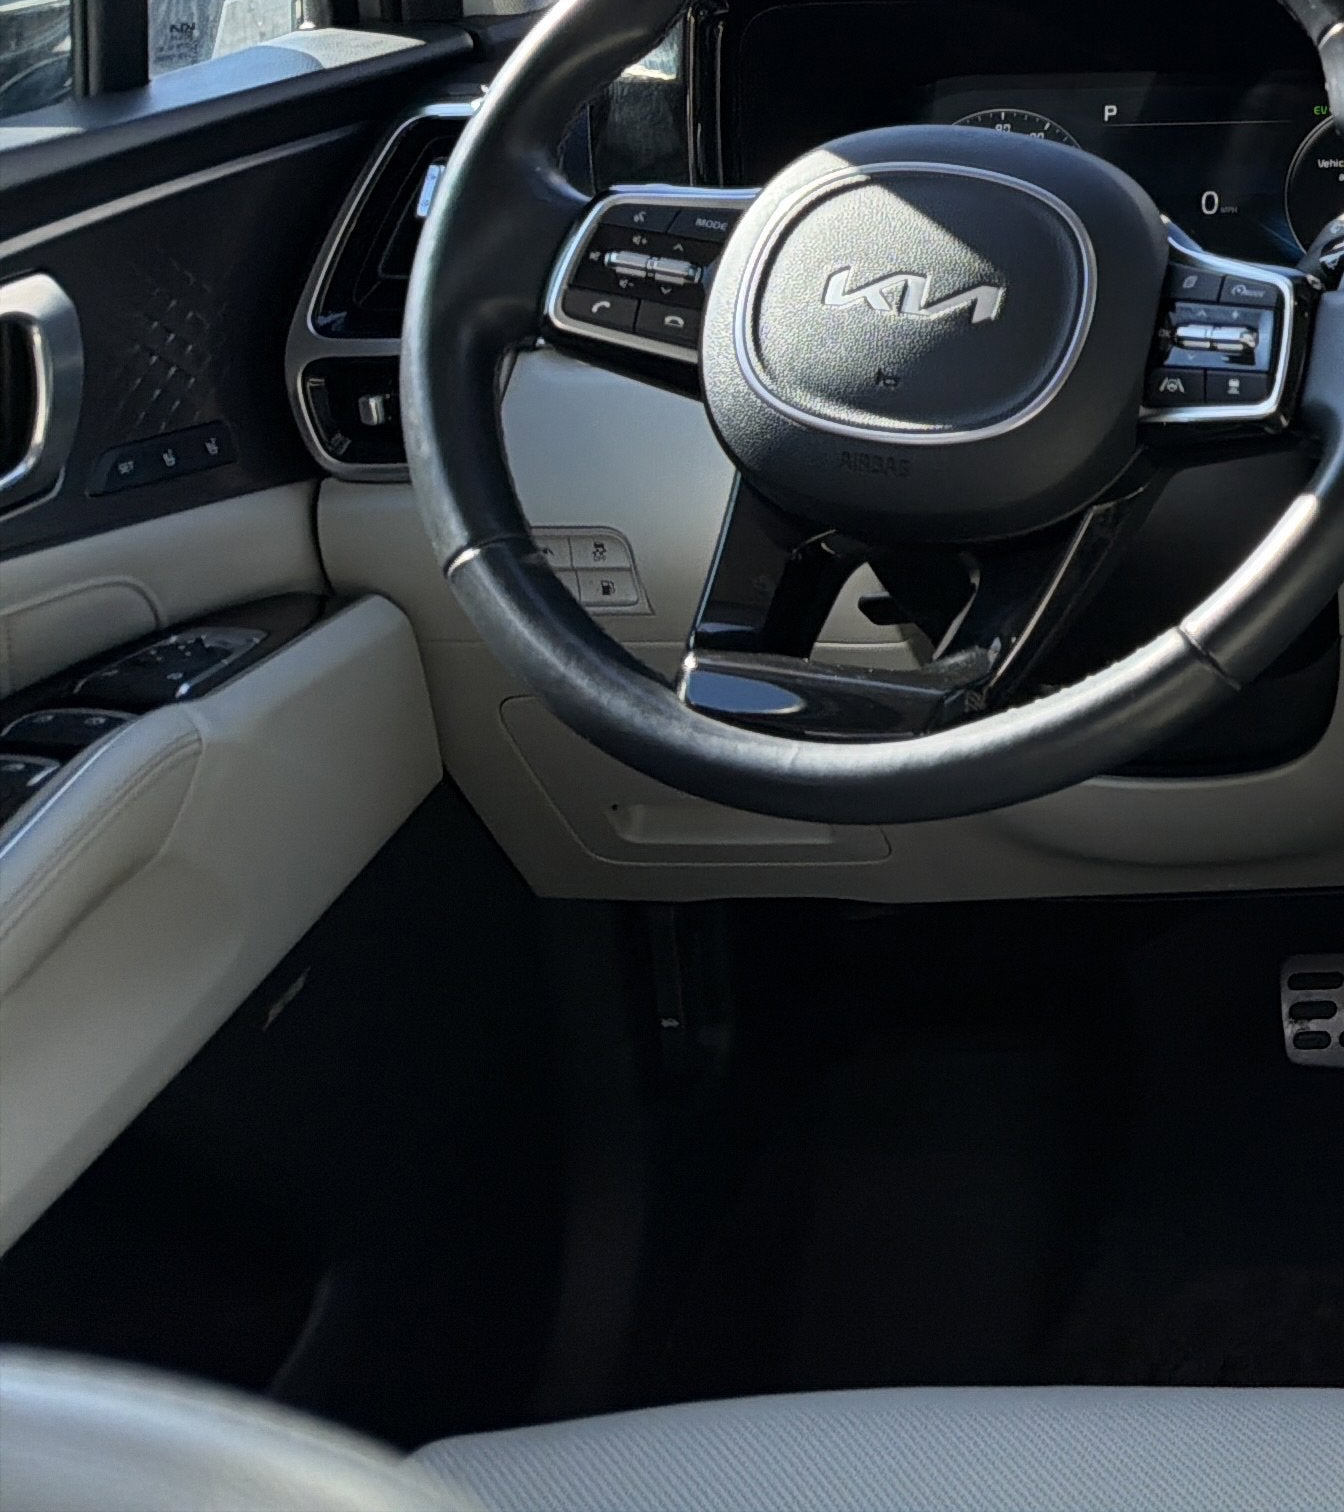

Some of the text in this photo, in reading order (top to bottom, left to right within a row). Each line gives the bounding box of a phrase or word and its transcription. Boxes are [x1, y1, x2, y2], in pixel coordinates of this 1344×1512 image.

[1104, 105, 1117, 122] P
[1313, 106, 1328, 115] EV
[1201, 190, 1219, 215] 0
[695, 218, 728, 231] MODE
[822, 265, 1007, 324] KIA
